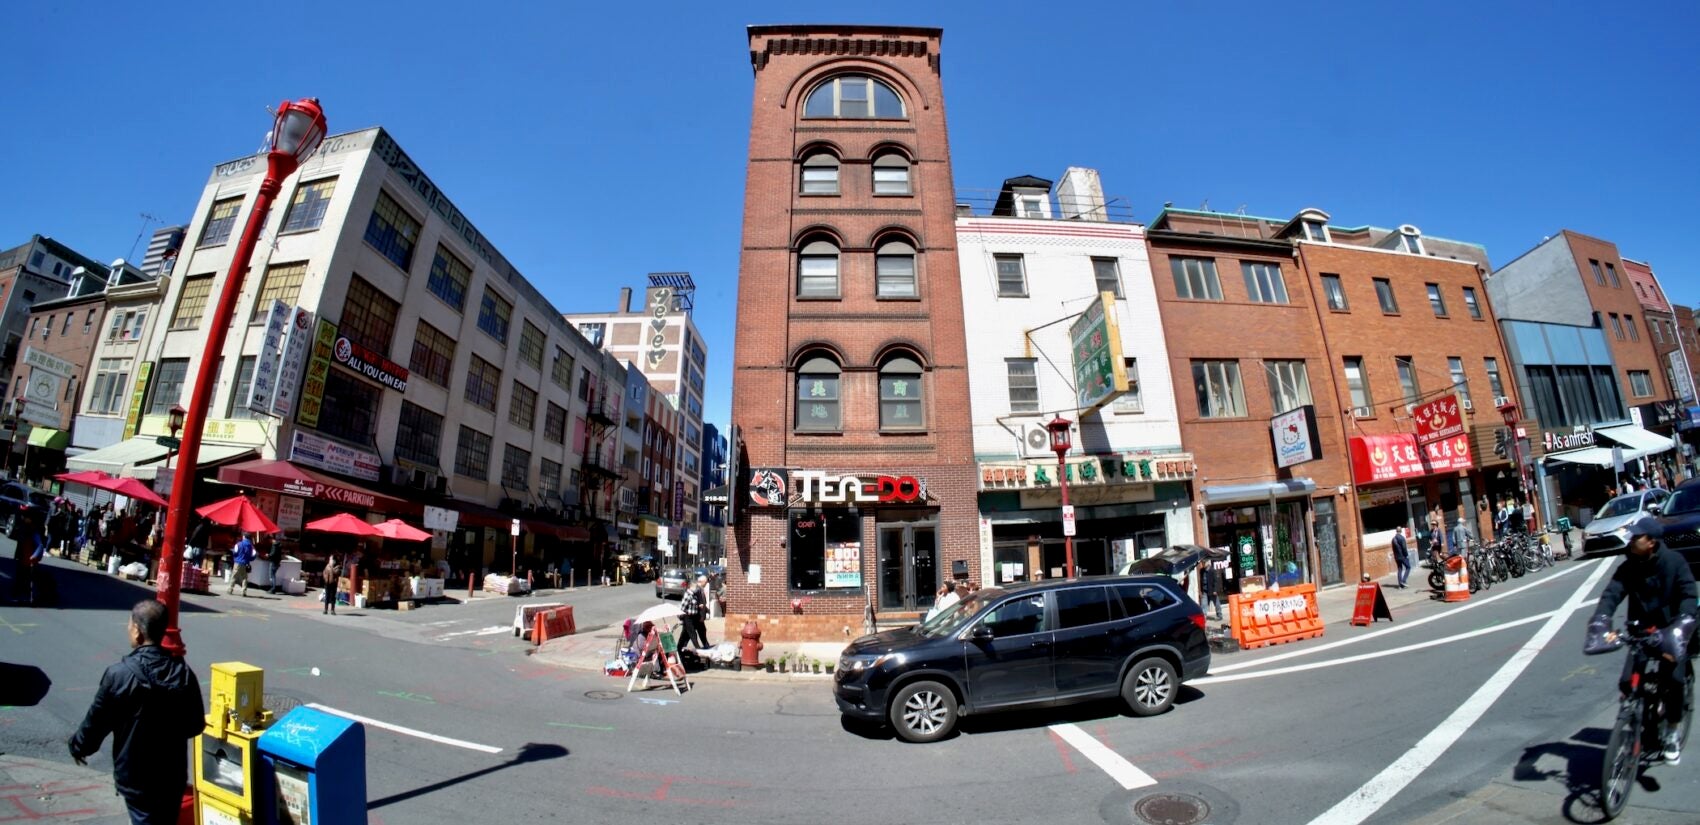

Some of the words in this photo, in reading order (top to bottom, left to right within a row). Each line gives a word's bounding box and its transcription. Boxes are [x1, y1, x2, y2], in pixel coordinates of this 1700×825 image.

[347, 356, 362, 372] ALL
[363, 362, 379, 379] YOU
[378, 371, 394, 387] CAN
[392, 378, 407, 392] EAT
[1439, 424, 1462, 437] RESTAURANT
[314, 483, 325, 497] P
[343, 489, 375, 507] PARKING
[797, 520, 816, 529] open
[1259, 602, 1270, 612] NO
[1272, 597, 1305, 611] PARKING
